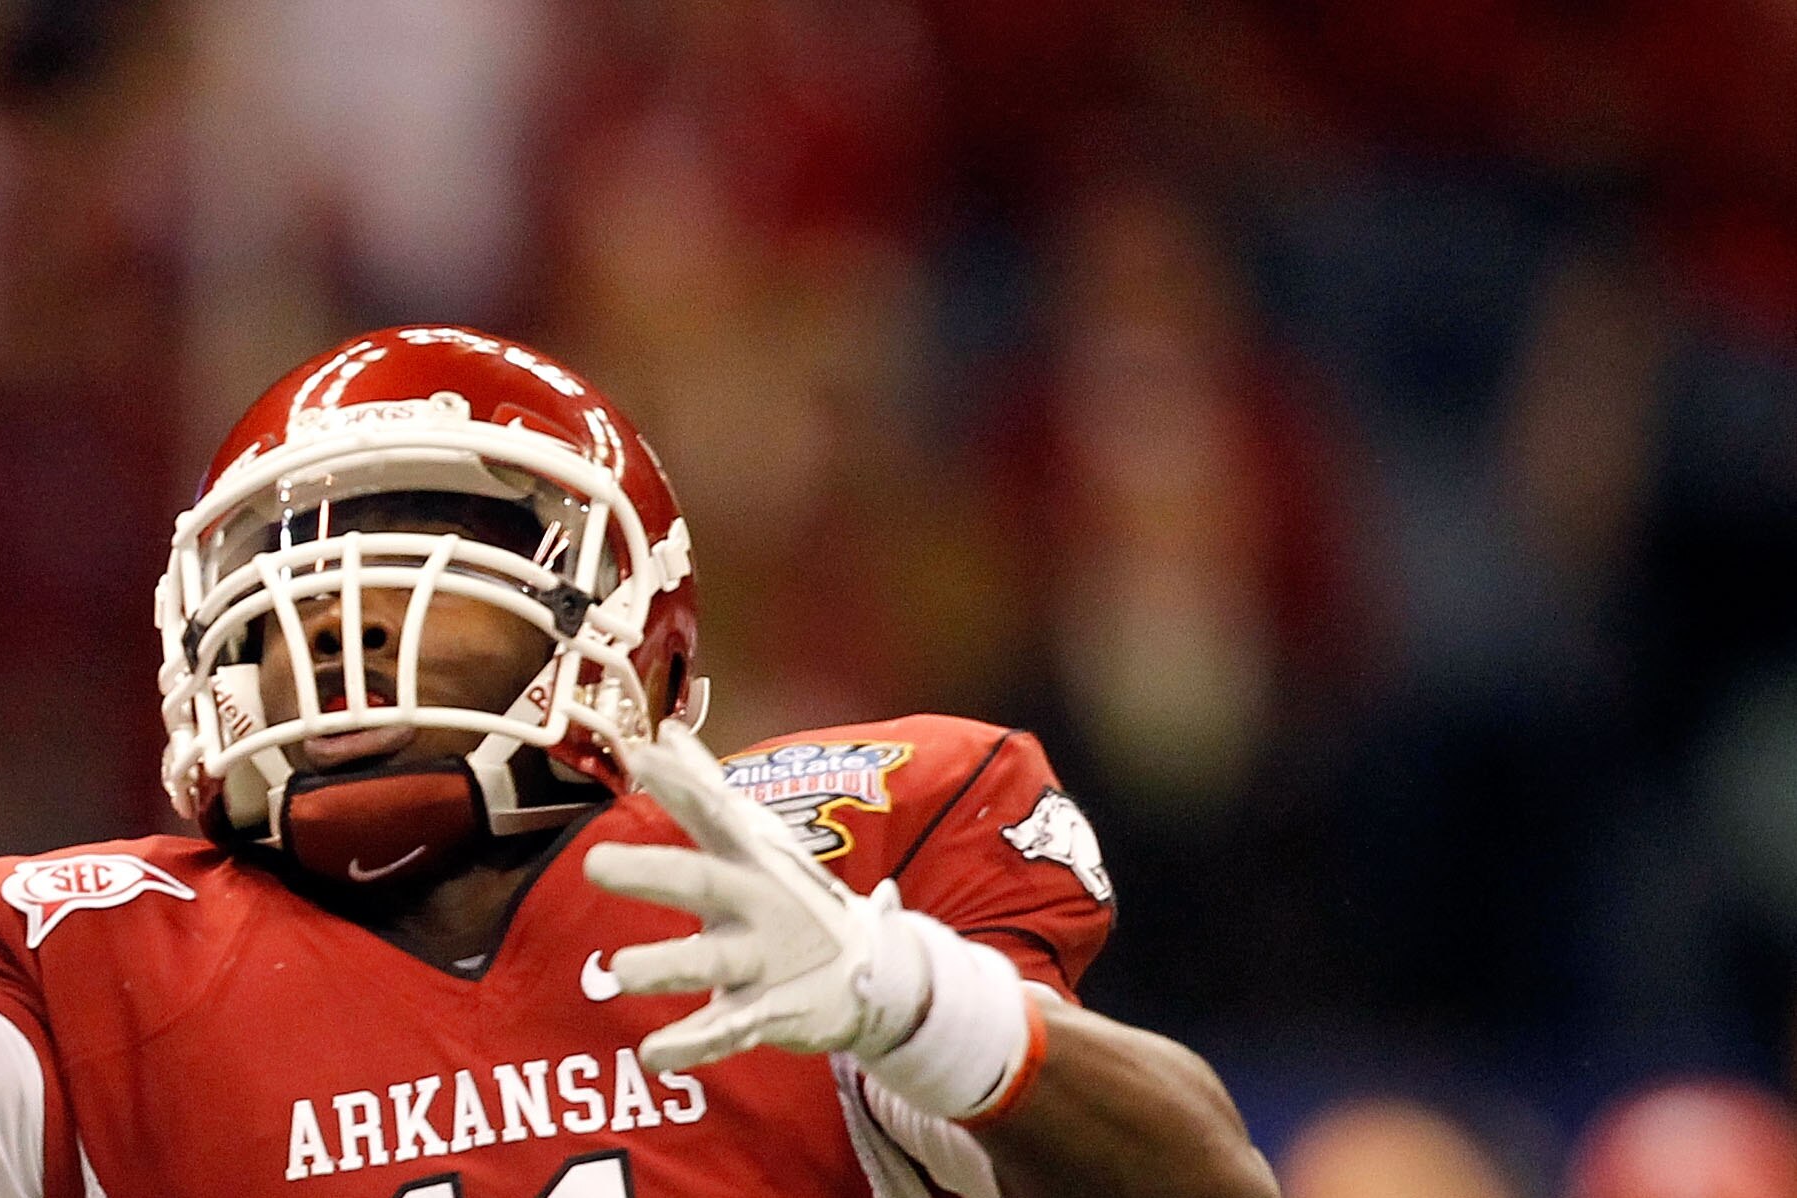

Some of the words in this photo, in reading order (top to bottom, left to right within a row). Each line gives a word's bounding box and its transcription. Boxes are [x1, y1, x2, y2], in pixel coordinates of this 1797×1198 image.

[724, 754, 867, 787] Allstate
[51, 863, 112, 894] SEC
[285, 1047, 708, 1181] ARKANSAS
